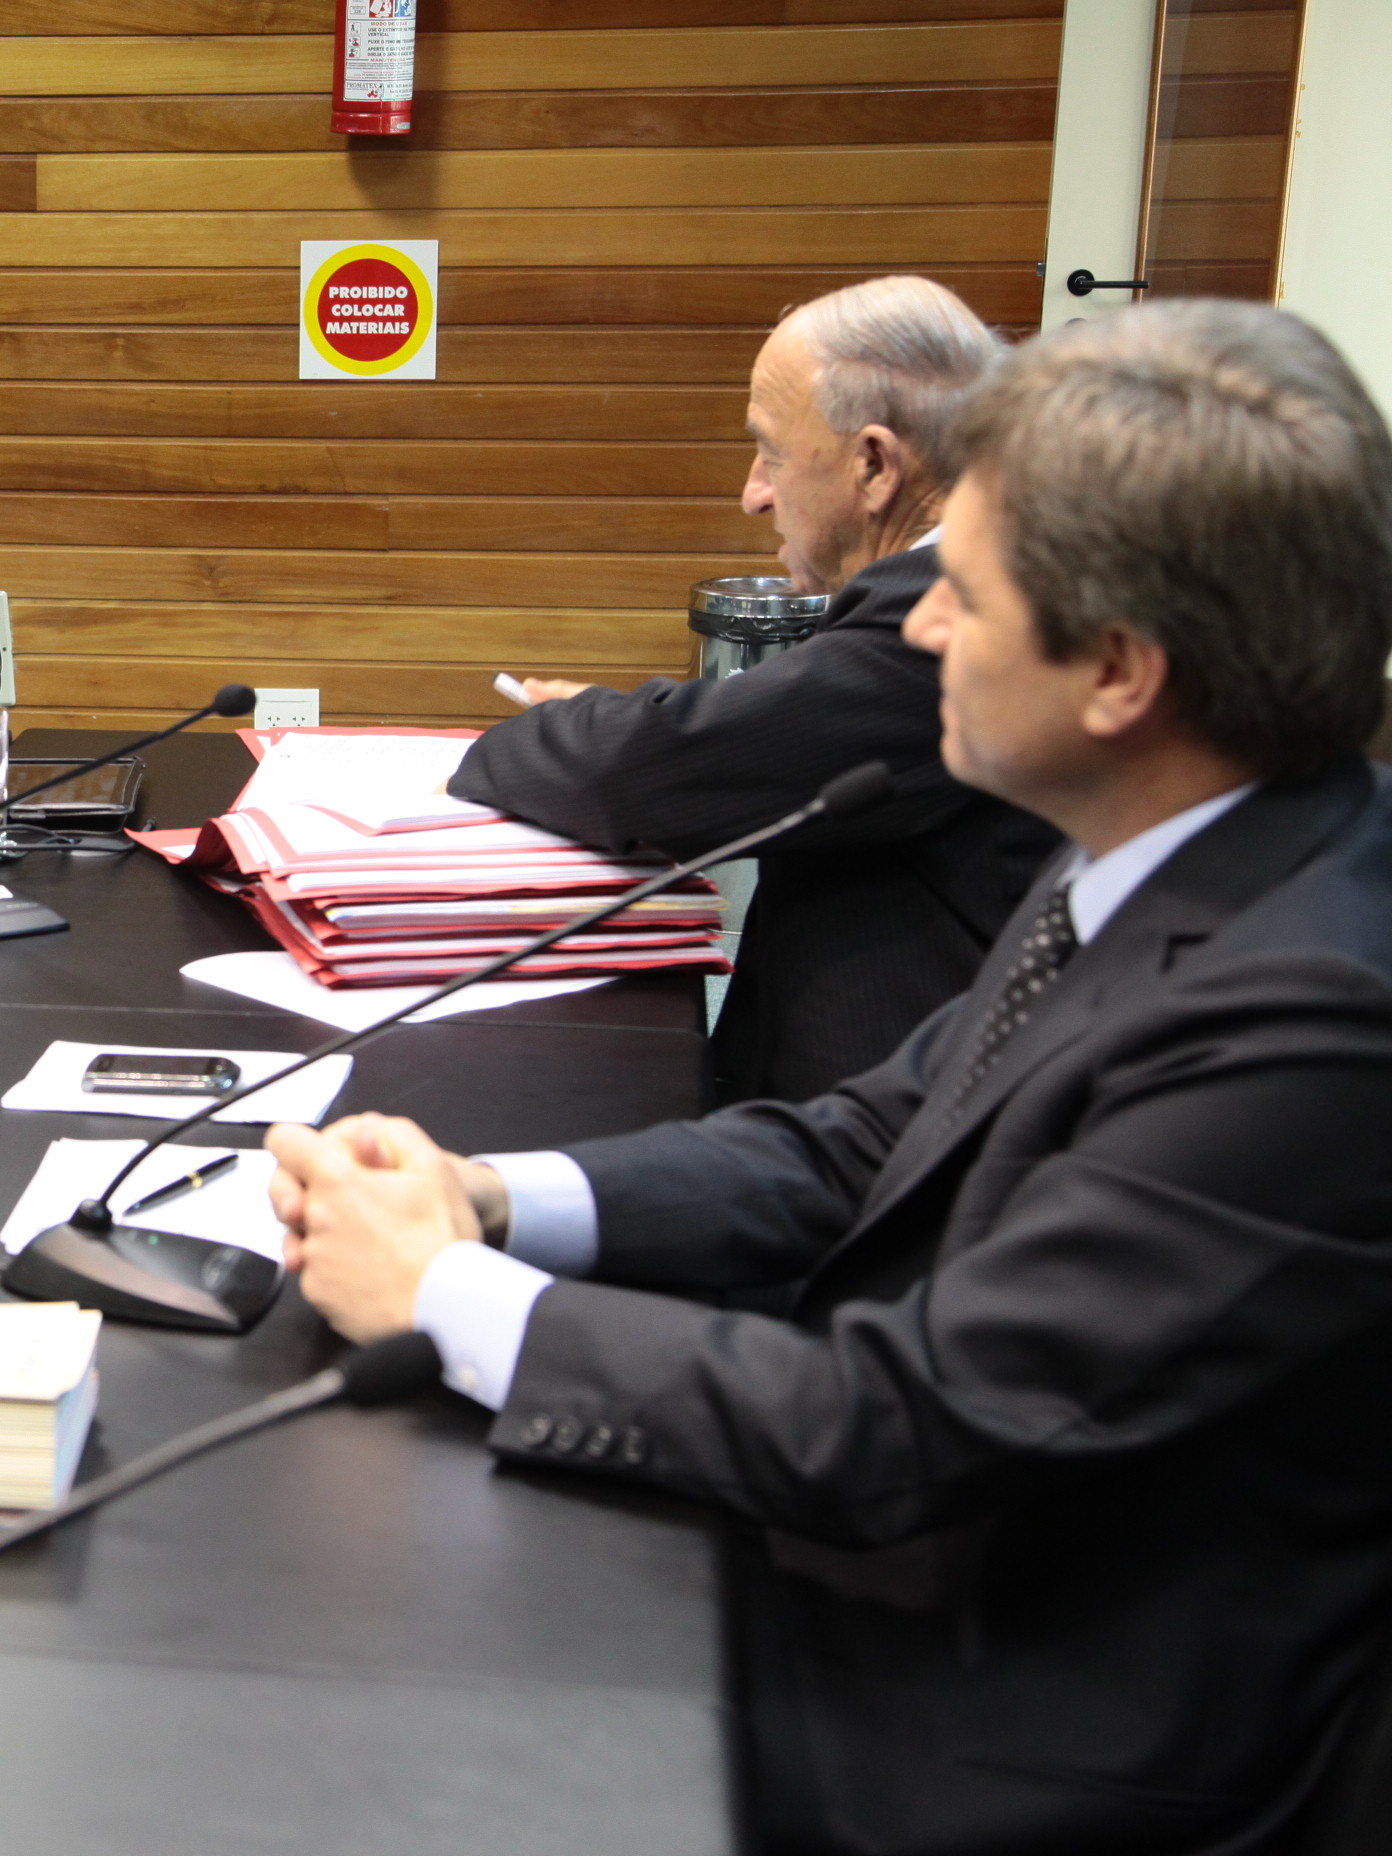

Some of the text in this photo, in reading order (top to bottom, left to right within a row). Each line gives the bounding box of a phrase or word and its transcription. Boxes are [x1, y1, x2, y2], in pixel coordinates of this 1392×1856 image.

[329, 286, 408, 298] PROIBIDO
[331, 304, 404, 316] COLOCAR
[326, 322, 410, 334] MATERIAIS
